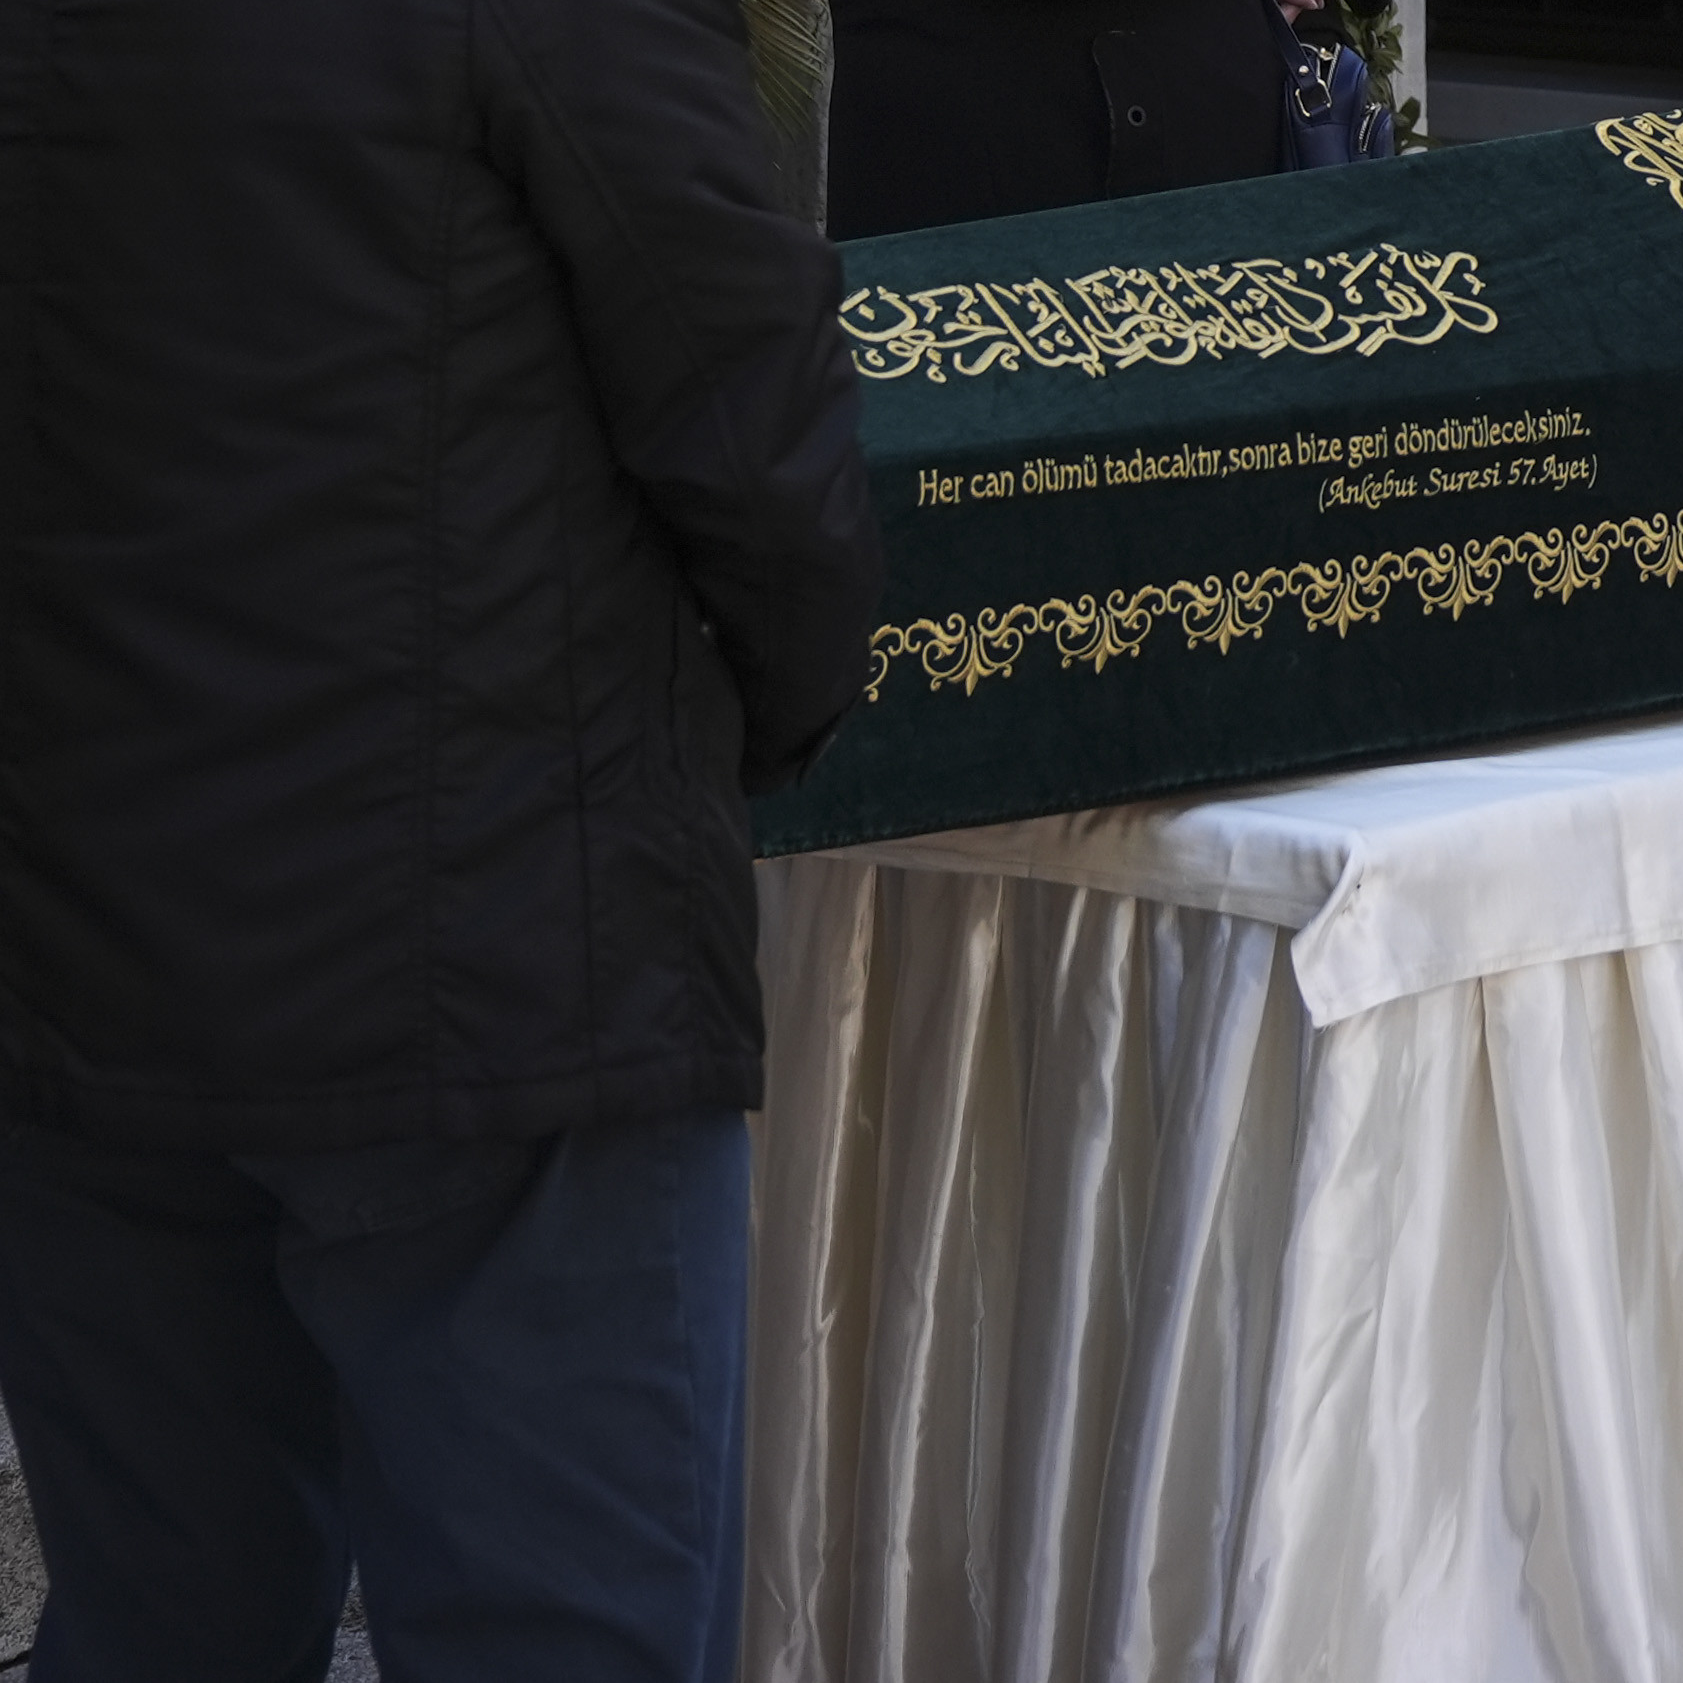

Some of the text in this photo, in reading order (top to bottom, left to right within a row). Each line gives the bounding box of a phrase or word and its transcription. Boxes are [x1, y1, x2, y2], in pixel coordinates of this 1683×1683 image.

[918, 468, 963, 507] Her
[970, 468, 1015, 499] can
[1022, 454, 1098, 495] ölümü
[1297, 431, 1343, 466] bize
[1349, 426, 1388, 469] geri
[1395, 407, 1591, 456] döndürüleceksiniz.
[1318, 468, 1418, 514] (Ankebut
[1424, 461, 1502, 496] Suresi
